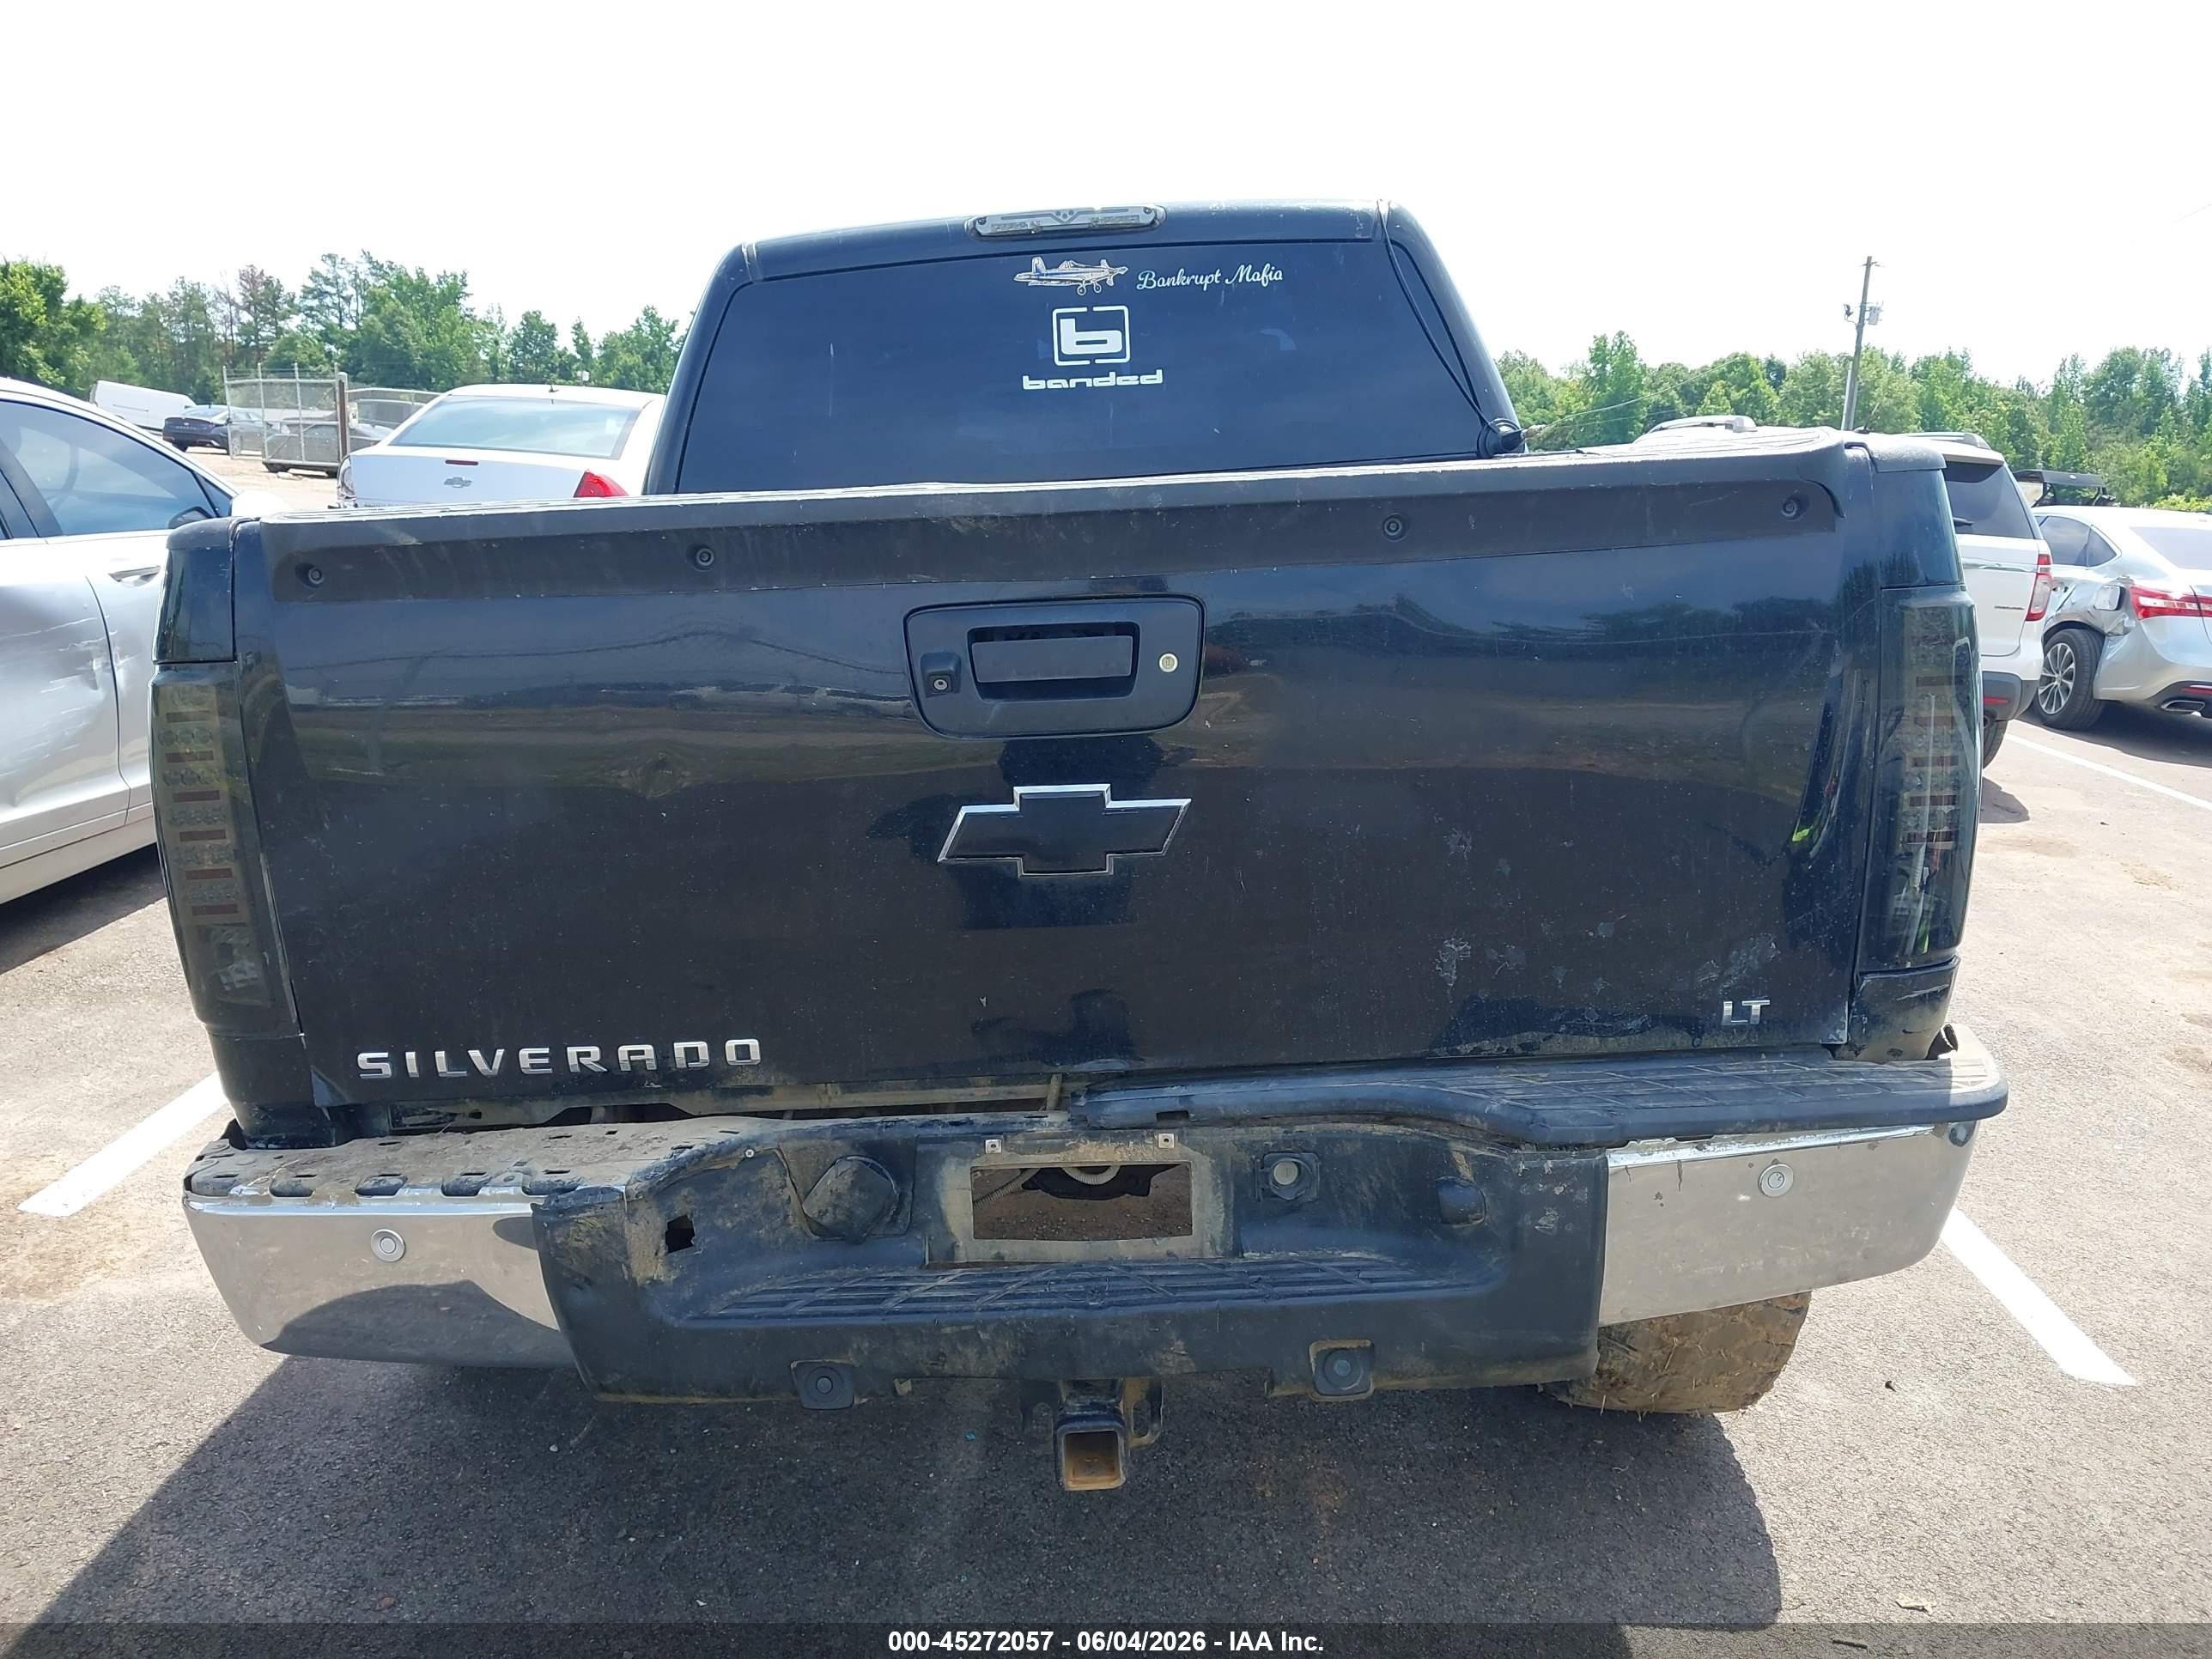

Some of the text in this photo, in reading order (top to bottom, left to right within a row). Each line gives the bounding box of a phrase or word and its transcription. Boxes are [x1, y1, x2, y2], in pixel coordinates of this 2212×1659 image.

[1136, 263, 1283, 291] Bankrupt Mafia
[1022, 369, 1164, 390] banded
[1721, 1000, 1771, 1025] LT
[357, 1038, 762, 1079] SILVERADO
